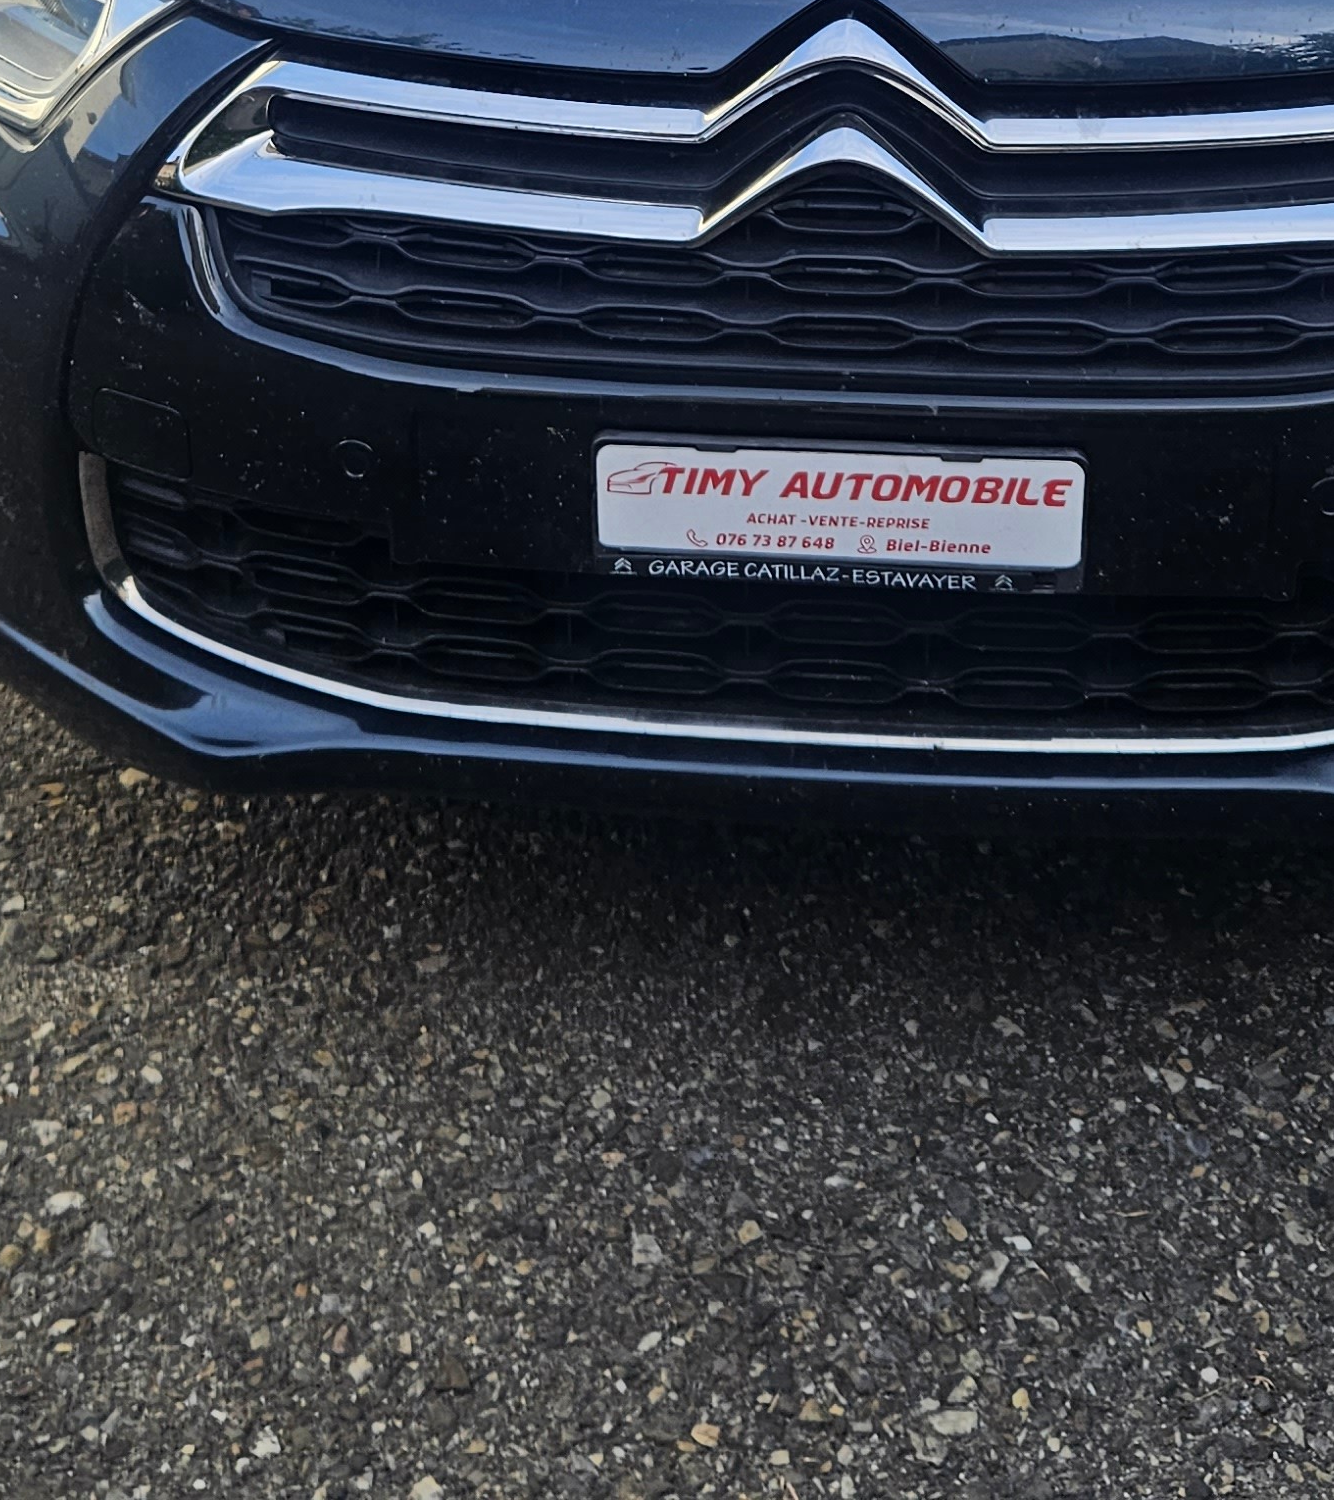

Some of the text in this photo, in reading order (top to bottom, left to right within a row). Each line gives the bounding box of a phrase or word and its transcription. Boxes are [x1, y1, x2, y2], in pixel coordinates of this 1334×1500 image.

[659, 467, 1073, 507] TIMY AUTOMOBILE
[746, 512, 797, 526] ACHAT
[716, 532, 835, 550] 076 73 87 648
[886, 539, 992, 554] Biel-Bienne
[648, 559, 740, 577] GARAGE
